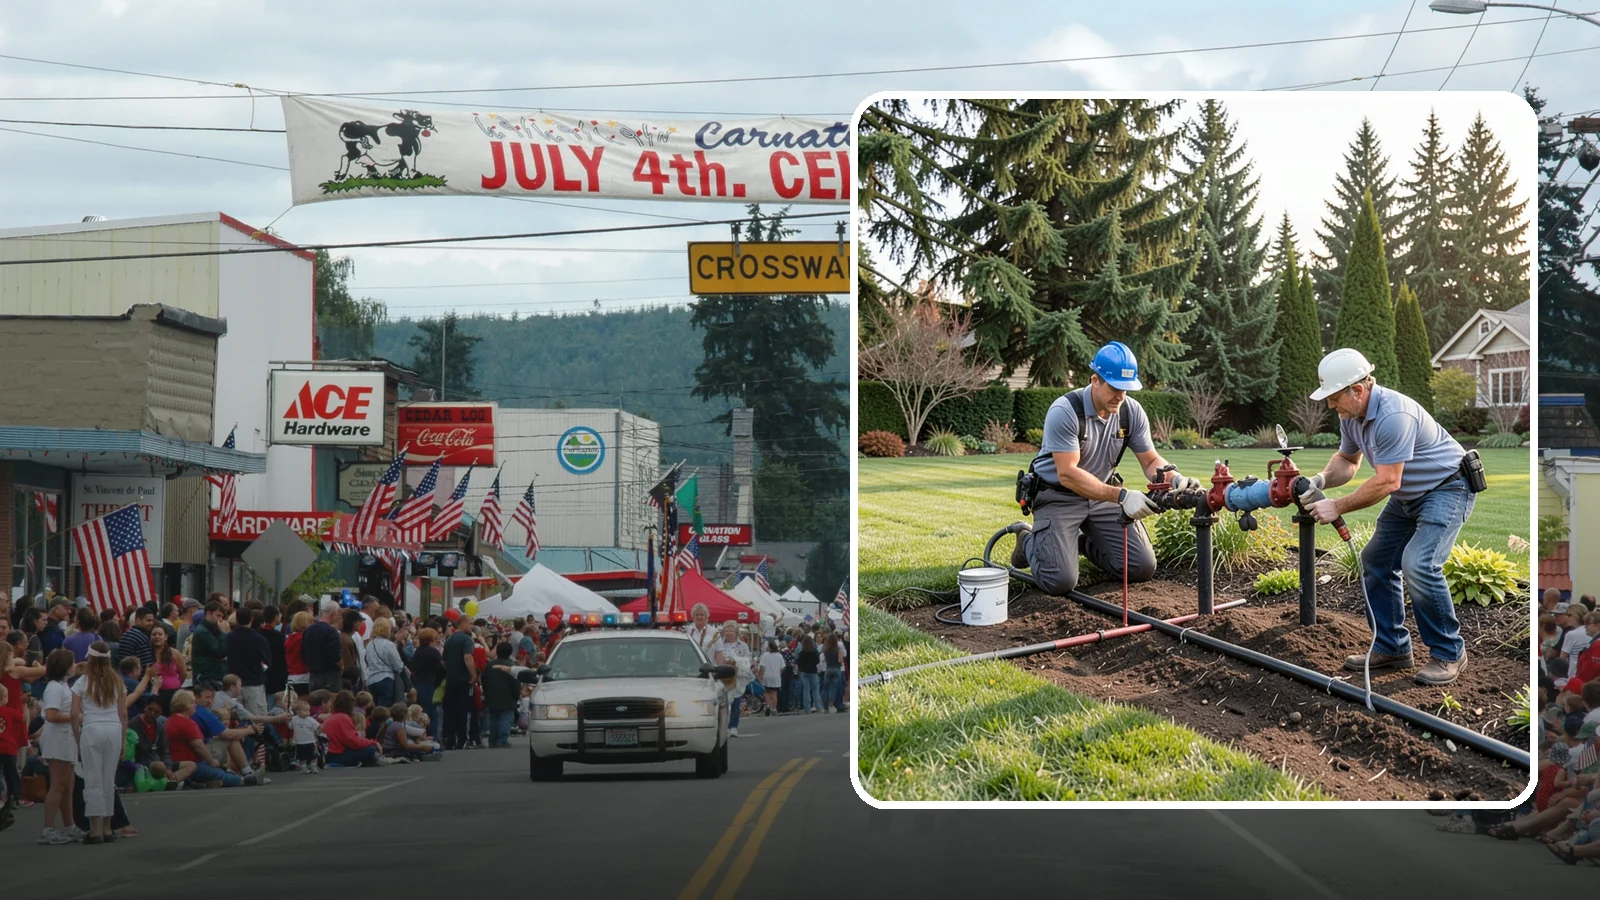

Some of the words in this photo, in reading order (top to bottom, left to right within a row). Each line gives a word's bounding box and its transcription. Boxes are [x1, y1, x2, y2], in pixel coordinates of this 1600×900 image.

[694, 121, 850, 150] Carnat
[481, 140, 605, 193] JULY
[632, 150, 746, 198] 4th.
[696, 254, 850, 280] CROSSWA
[282, 379, 374, 420] ACE
[405, 409, 453, 423] CEDAR
[283, 421, 371, 437] Hardware
[83, 485, 94, 494] St.
[95, 485, 124, 495] Vincent
[126, 486, 136, 495] de
[137, 486, 155, 495] Paul
[699, 535, 730, 543] GLASS
